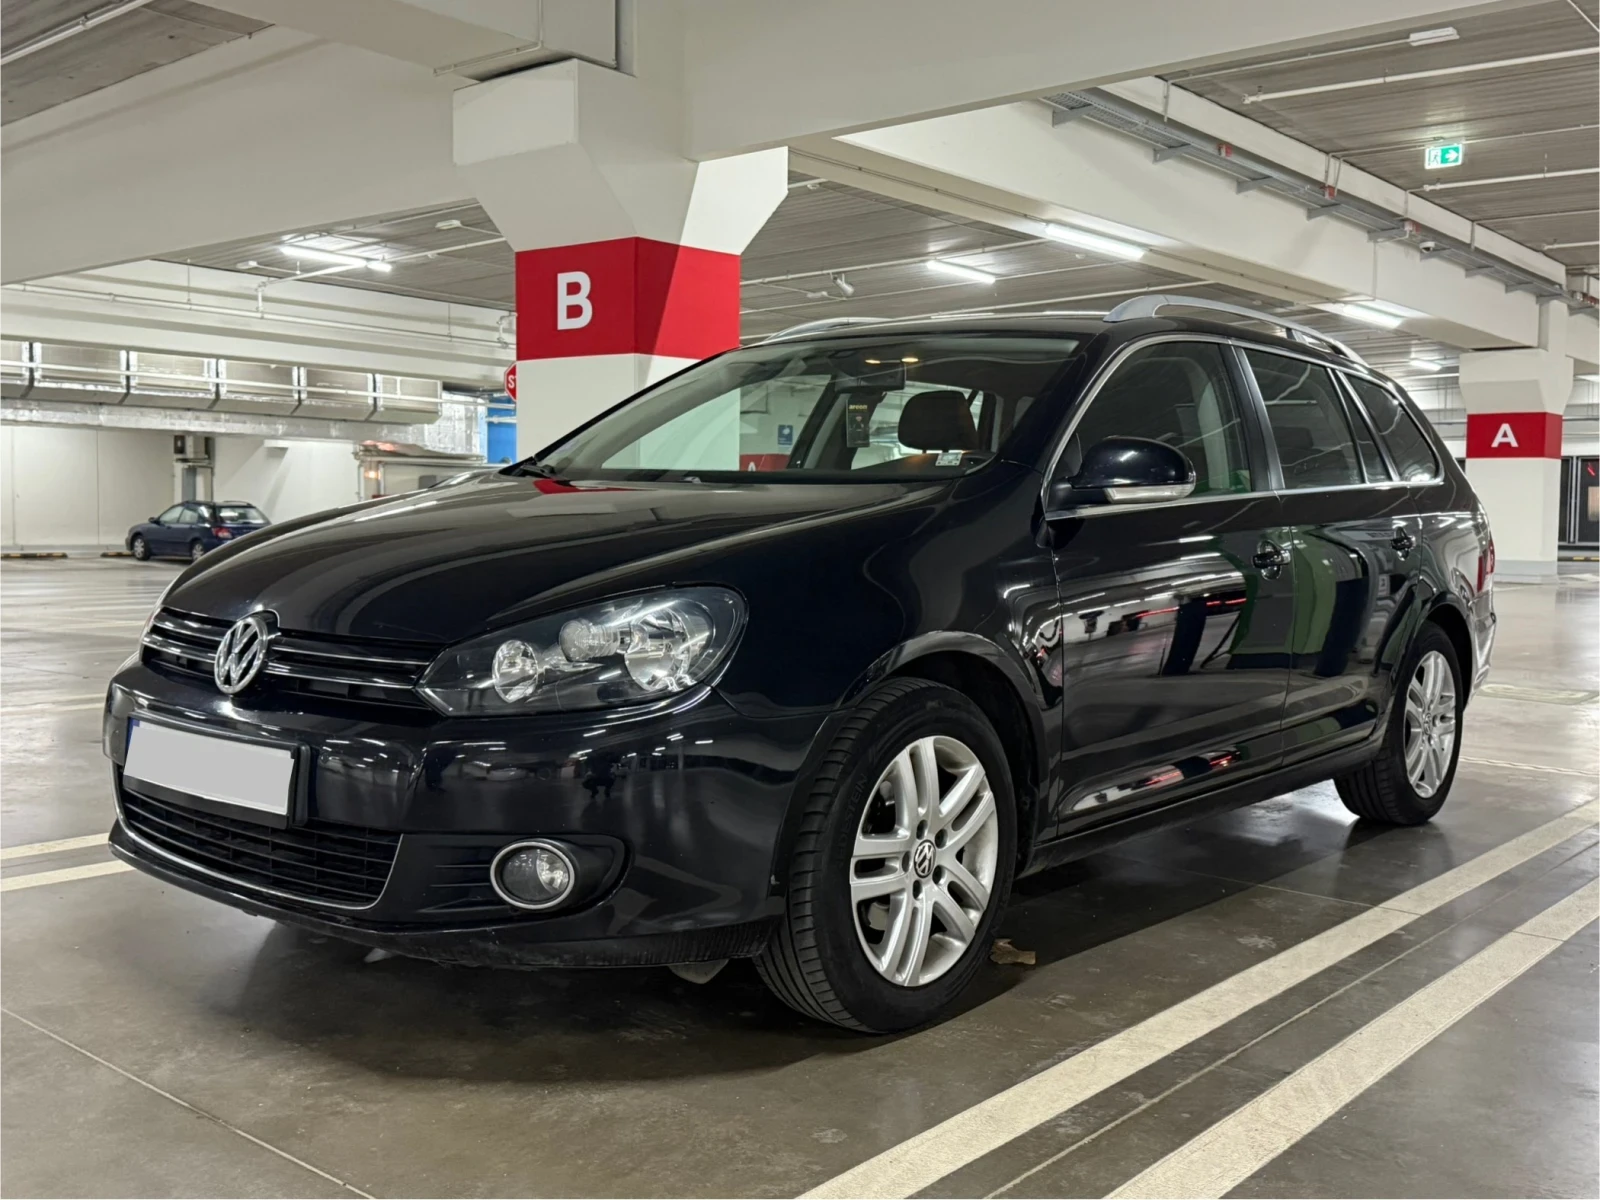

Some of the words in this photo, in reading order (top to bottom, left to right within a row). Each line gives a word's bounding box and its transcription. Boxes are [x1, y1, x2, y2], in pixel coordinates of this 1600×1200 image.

[557, 271, 593, 330] B
[508, 374, 517, 389] S
[1491, 423, 1519, 448] A
